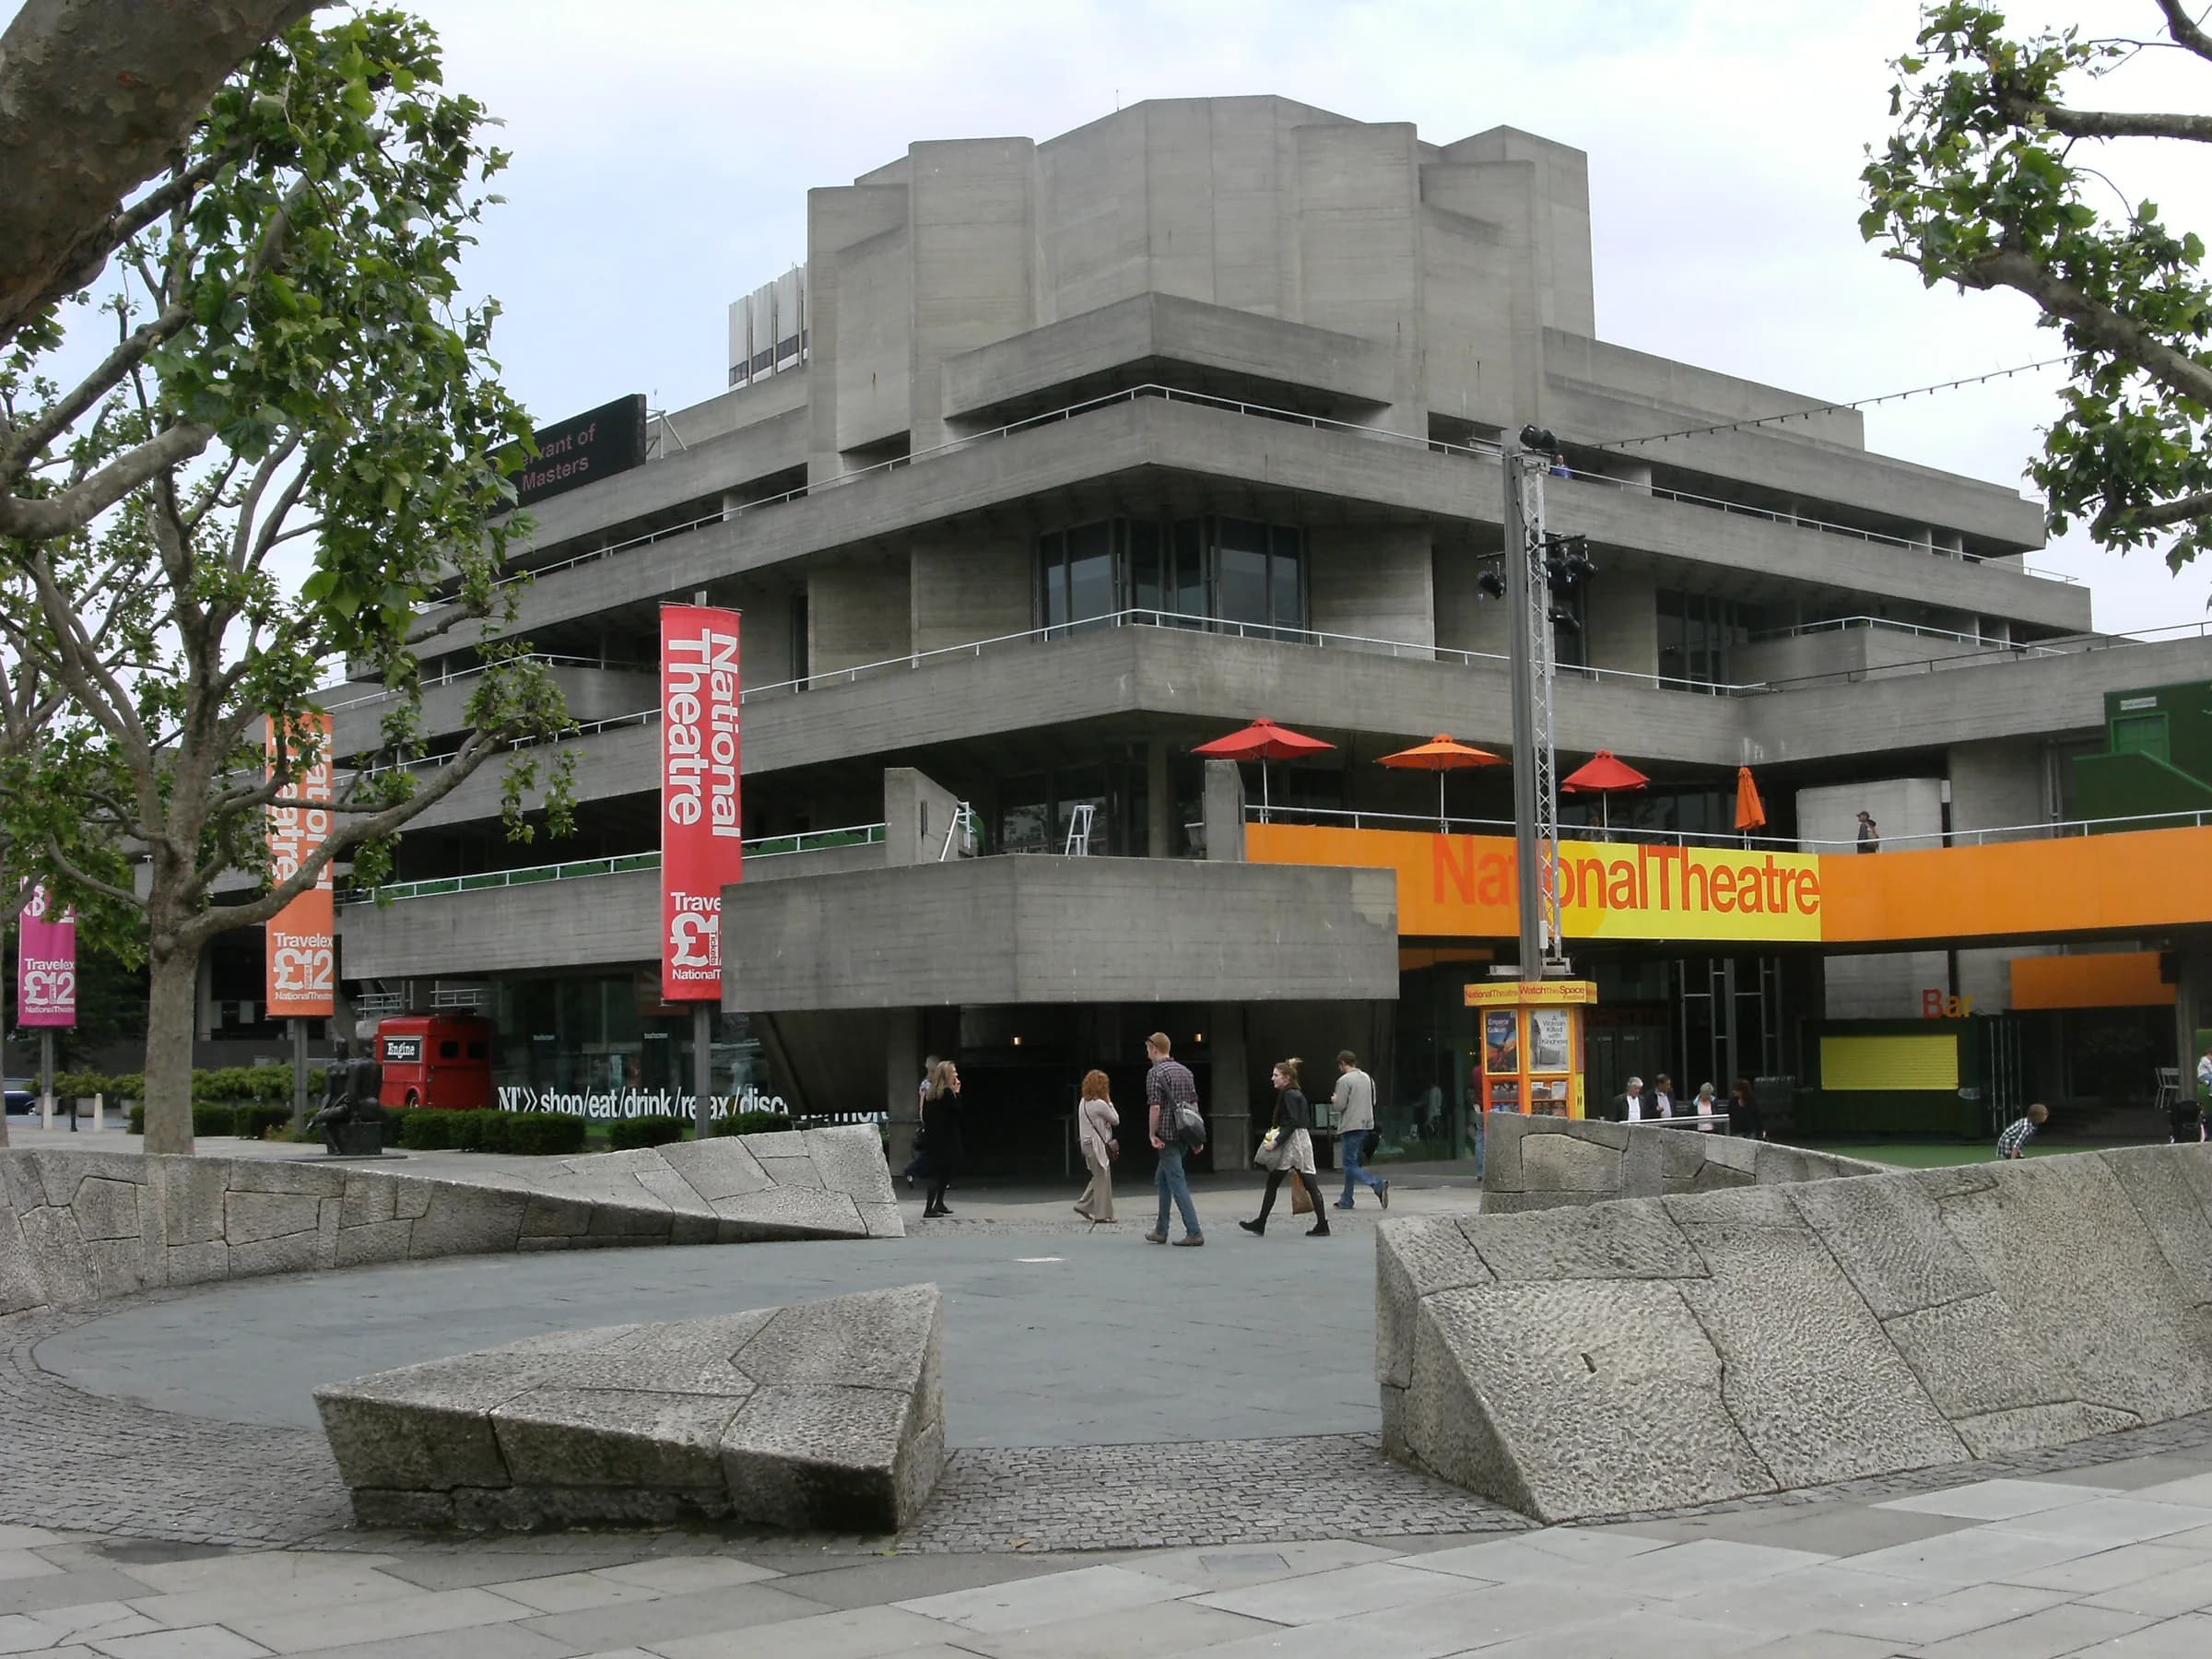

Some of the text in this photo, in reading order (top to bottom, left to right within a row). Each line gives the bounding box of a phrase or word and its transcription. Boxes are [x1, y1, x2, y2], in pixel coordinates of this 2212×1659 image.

[578, 423, 596, 445] of
[522, 456, 590, 492] Masters
[668, 629, 711, 825] Theatre
[711, 633, 740, 838] National
[1431, 833, 1821, 915] NaonalTheatre
[273, 933, 333, 948] Travelex
[669, 912, 721, 967] £1
[24, 958, 75, 971] Travelex
[273, 947, 333, 991] £12
[24, 971, 75, 1005] £12
[1922, 987, 1976, 1018] Bar
